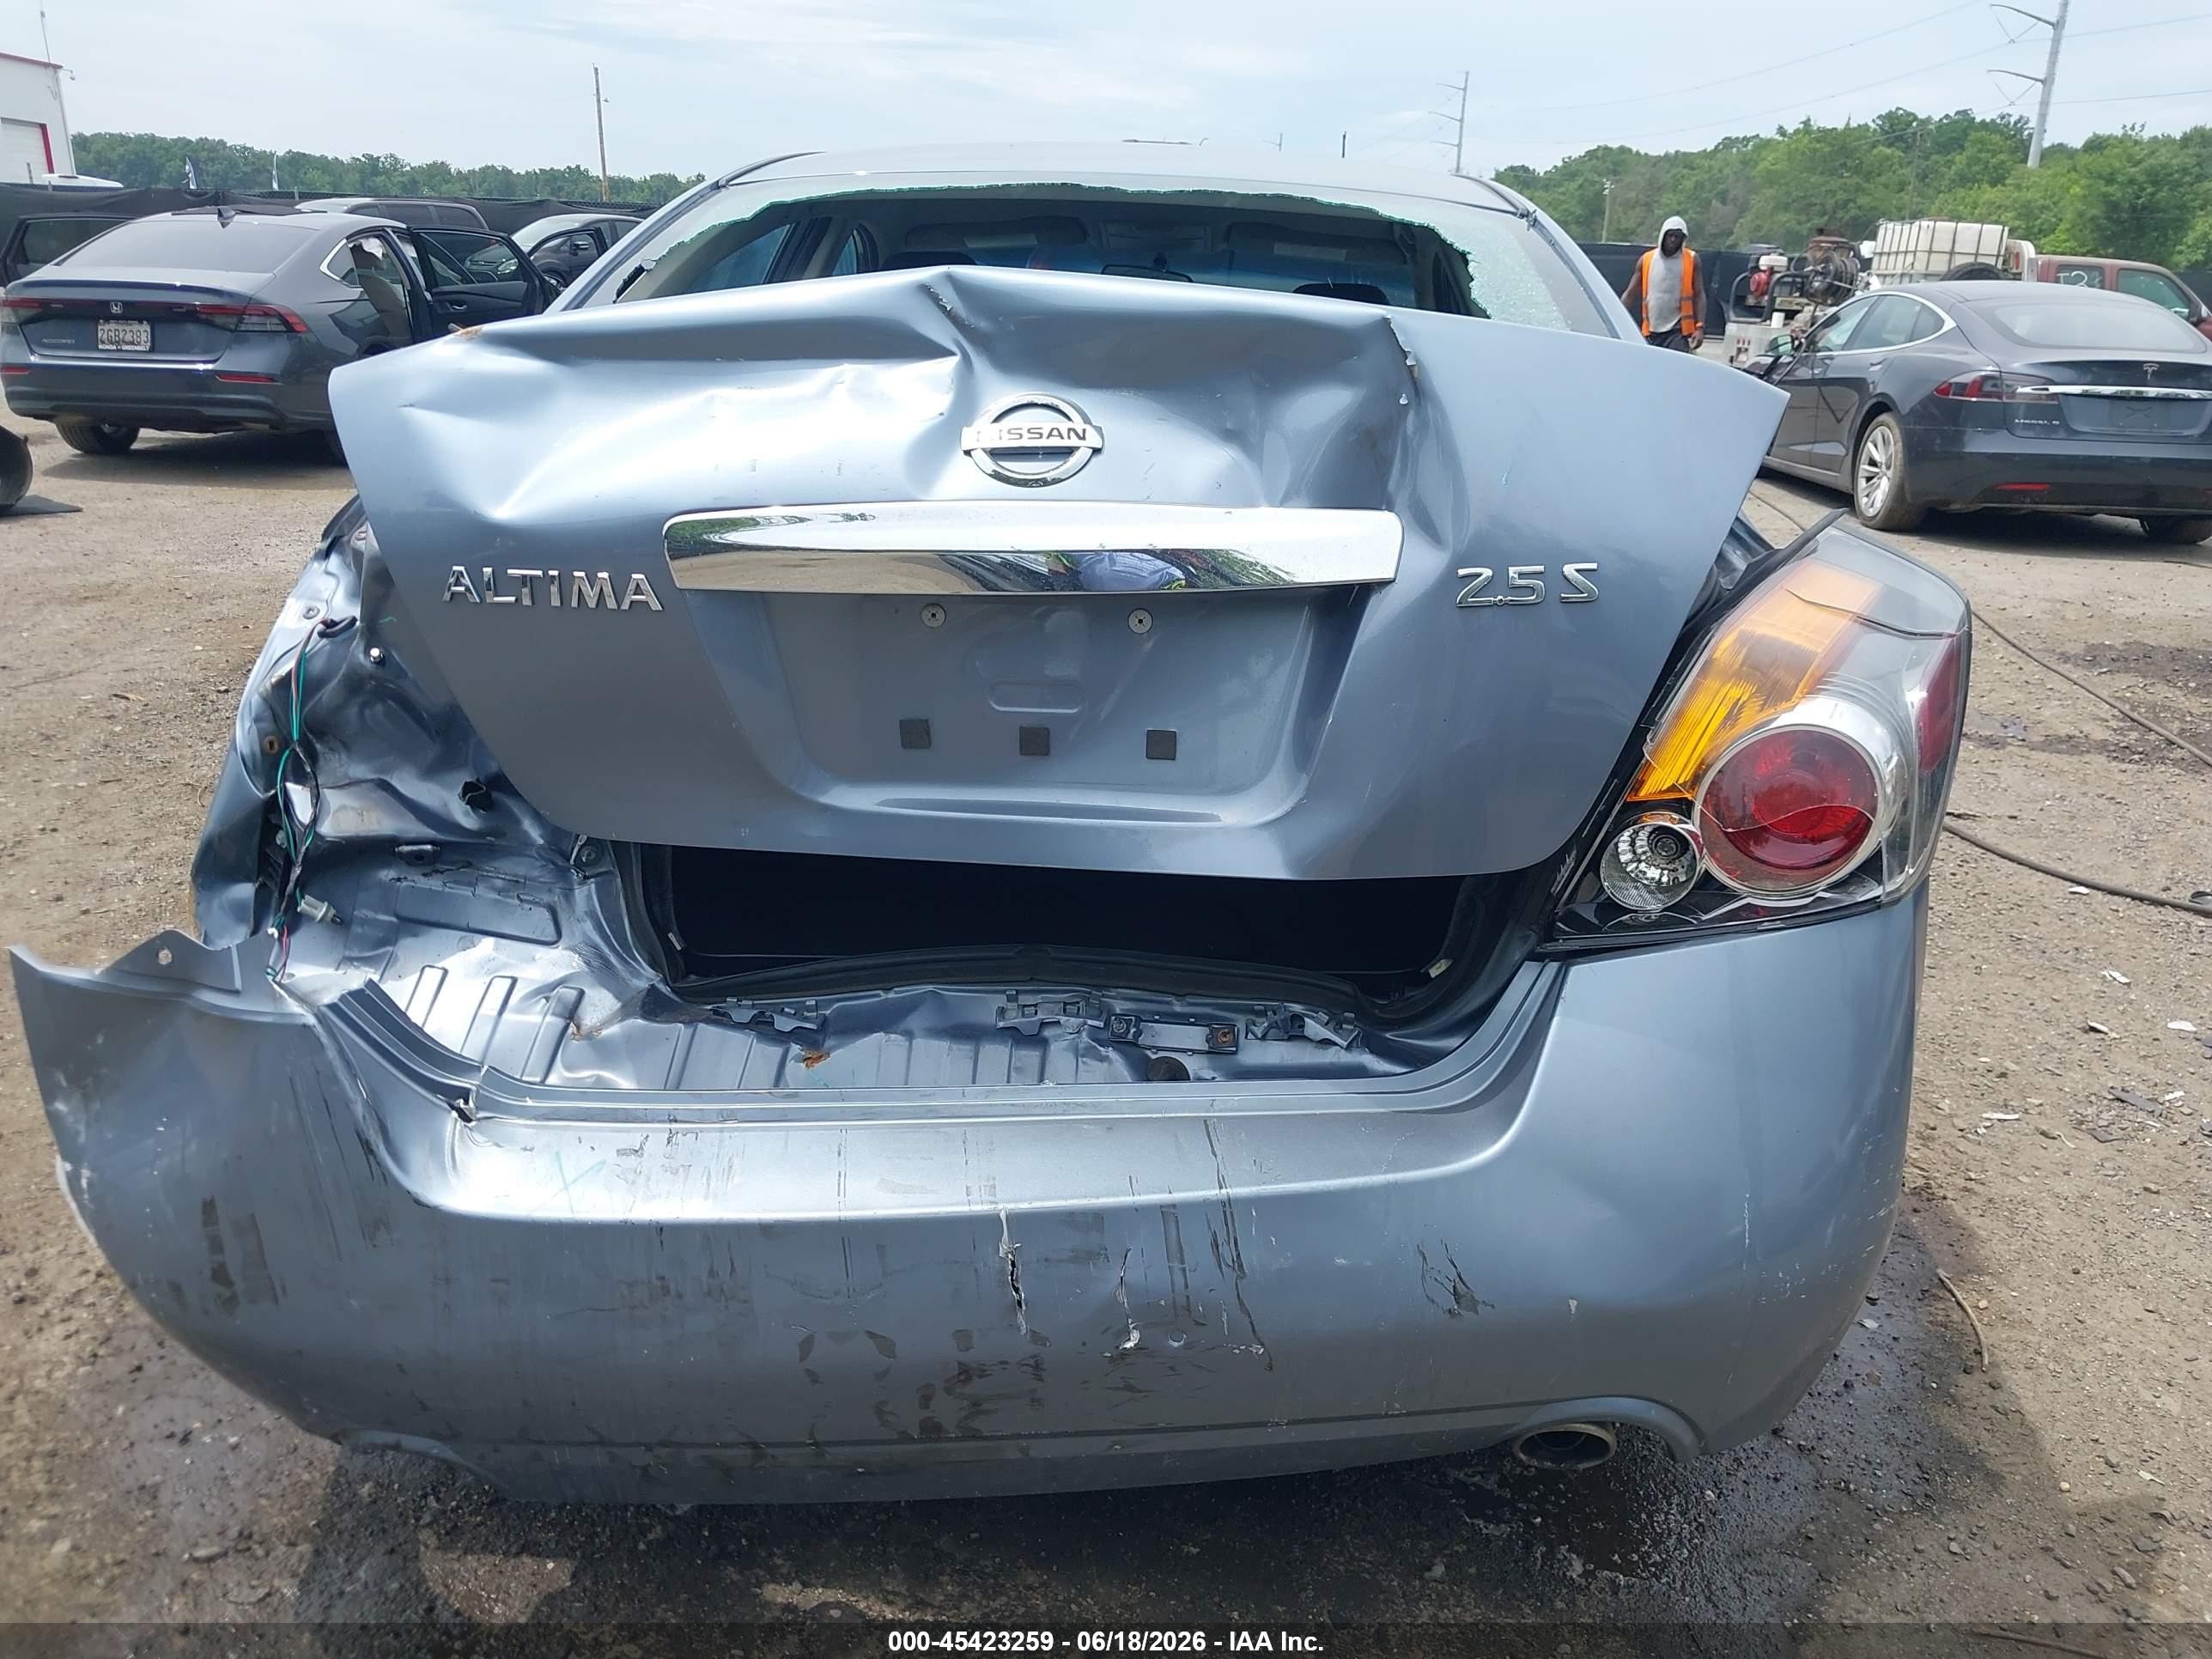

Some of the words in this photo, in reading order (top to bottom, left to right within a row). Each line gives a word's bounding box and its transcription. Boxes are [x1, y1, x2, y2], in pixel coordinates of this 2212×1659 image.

[99, 328, 149, 344] 2GB2383
[442, 565, 664, 611] ALTIMA
[1559, 562, 1599, 603] S
